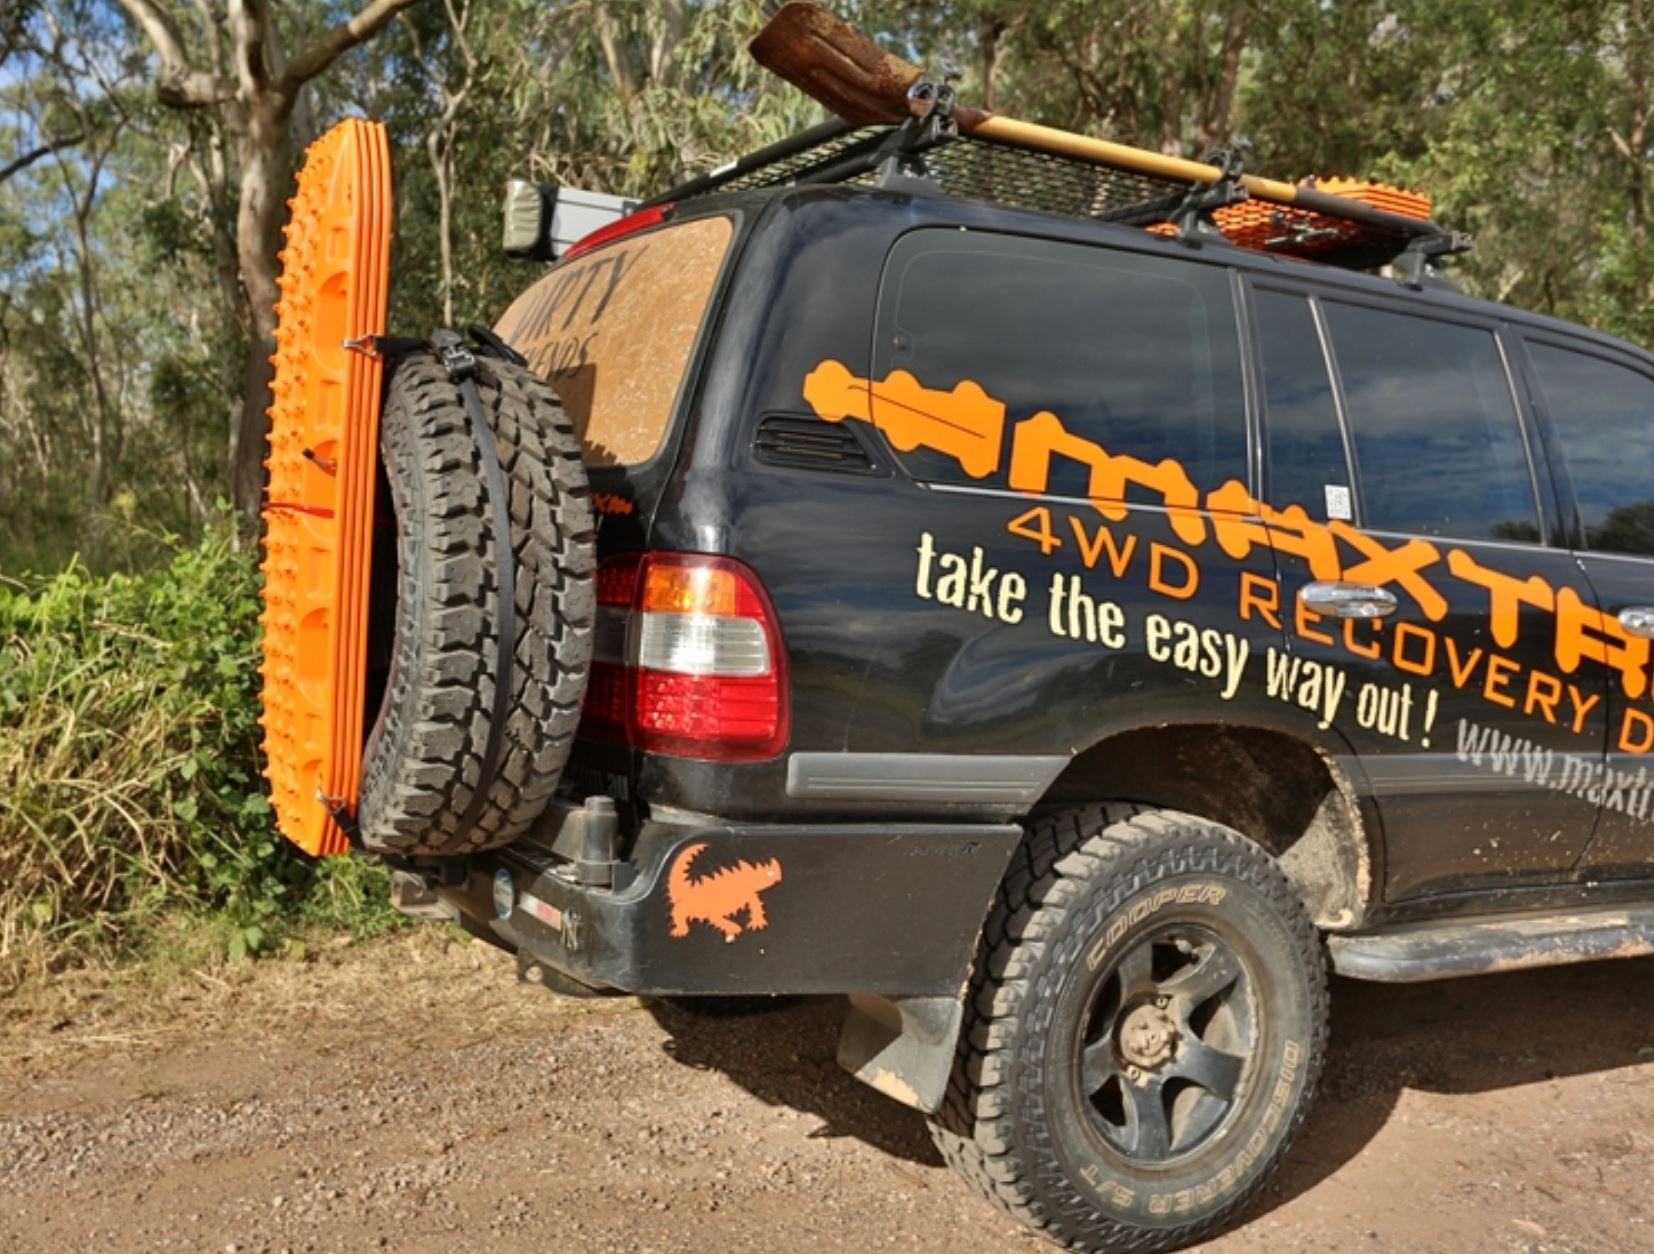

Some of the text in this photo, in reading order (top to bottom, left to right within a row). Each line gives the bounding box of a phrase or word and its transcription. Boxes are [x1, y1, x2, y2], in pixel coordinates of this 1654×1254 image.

[916, 531, 1027, 624] take
[1048, 572, 1127, 650] the
[1145, 614, 1249, 700] easy
[1266, 647, 1347, 731] way
[1007, 506, 1201, 600] 4WD
[1239, 571, 1600, 734] RECOVERY
[1087, 884, 1226, 972] COOPER
[1080, 1039, 1300, 1214] DISCOVERER S/T
